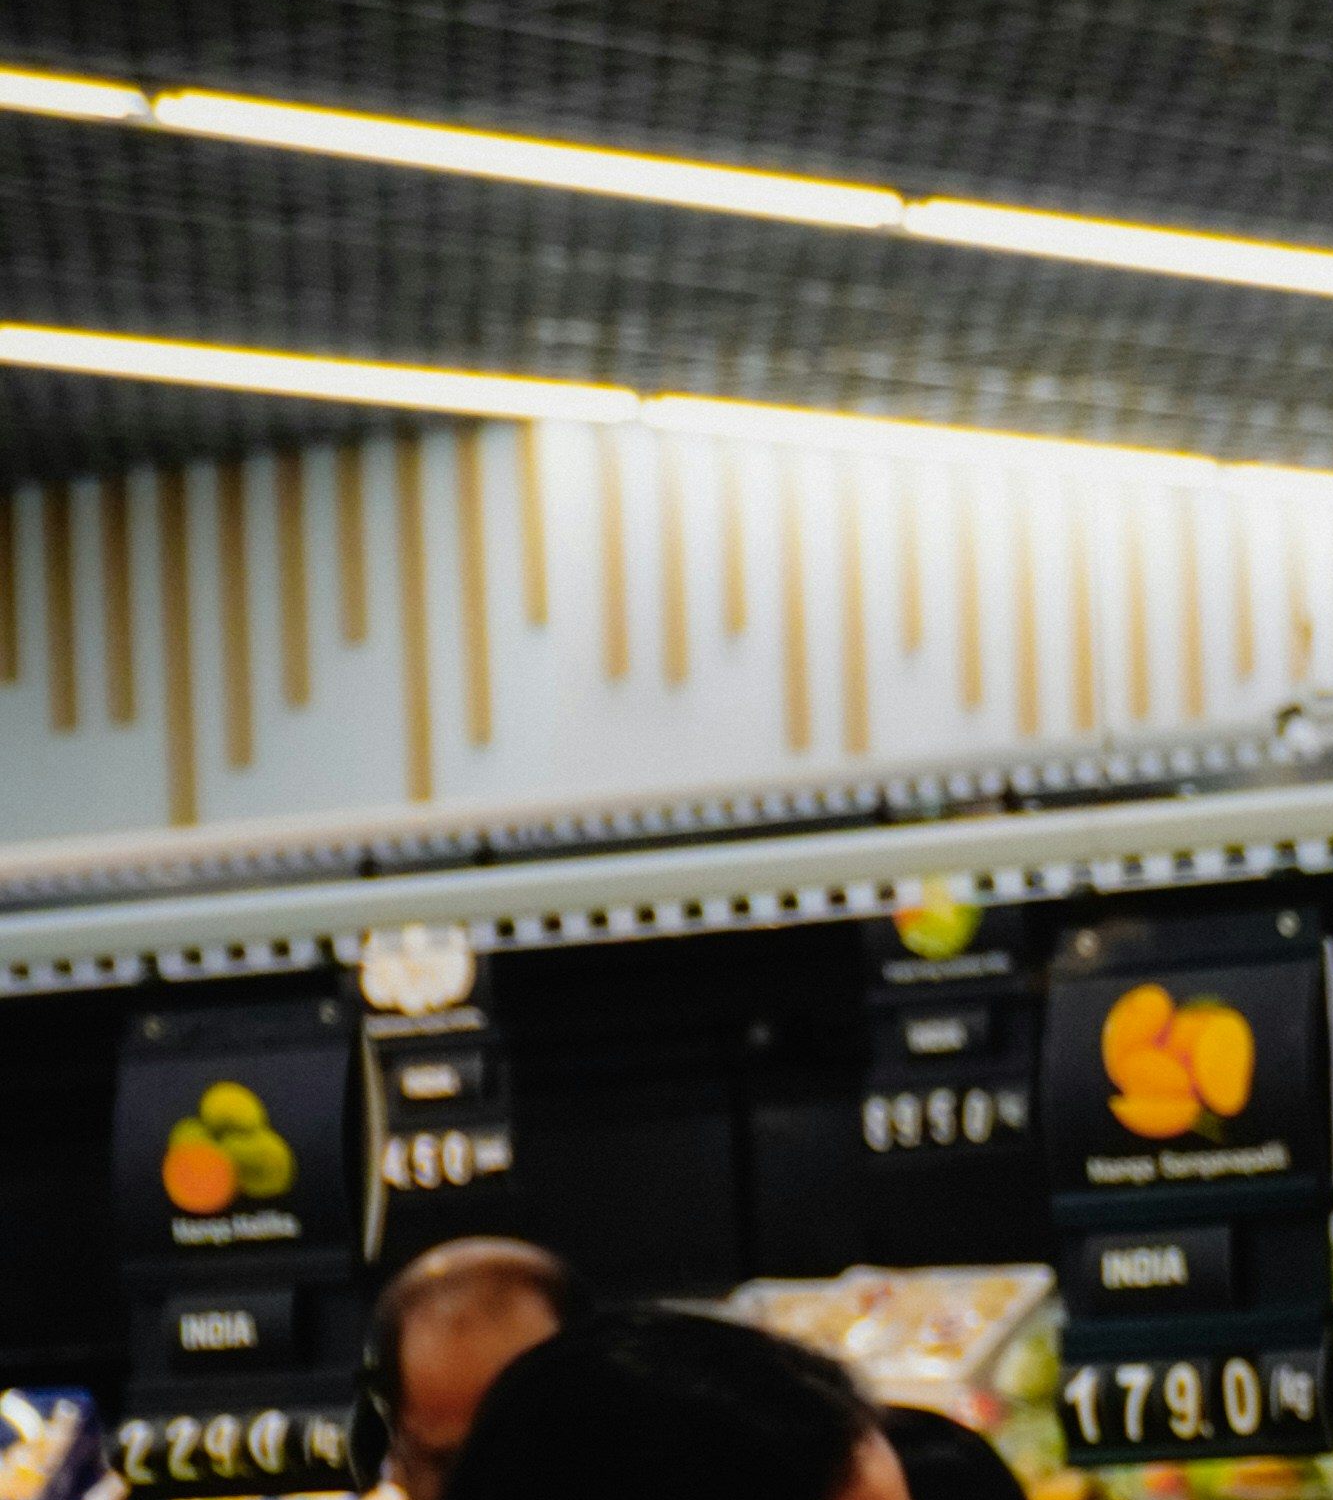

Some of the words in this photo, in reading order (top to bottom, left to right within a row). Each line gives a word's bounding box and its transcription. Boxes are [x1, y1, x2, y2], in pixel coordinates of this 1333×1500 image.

[1101, 1244, 1188, 1290] INDIA
[179, 1310, 258, 1351] INDIA
[1064, 1356, 1263, 1445] 179.0
